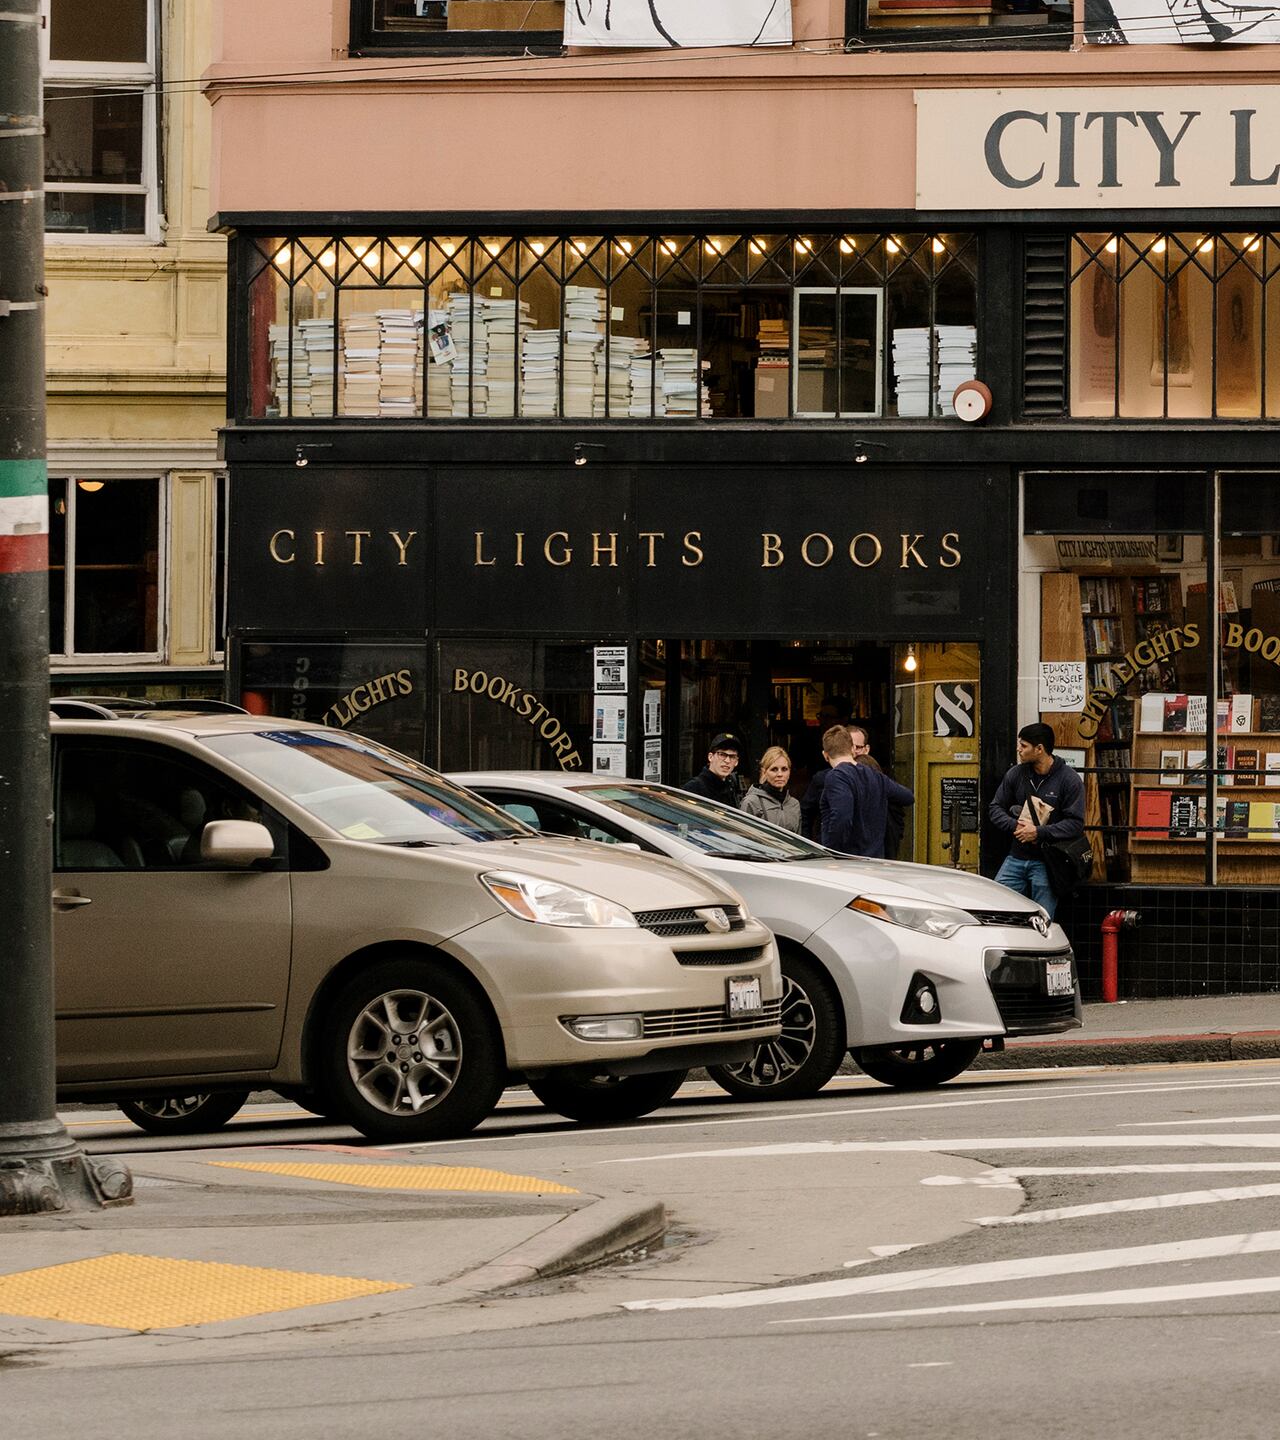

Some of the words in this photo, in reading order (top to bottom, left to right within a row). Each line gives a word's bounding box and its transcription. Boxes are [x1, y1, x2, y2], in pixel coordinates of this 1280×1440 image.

[983, 107, 1201, 189] CITY
[269, 529, 418, 566] CITY
[474, 531, 704, 568] LIGHTS
[761, 532, 963, 569] BOOKS
[1057, 540, 1077, 558] CITY
[1078, 540, 1107, 558] LIGHTS
[1043, 664, 1081, 675] EDUCATE
[1043, 675, 1082, 686] YOURSELF
[1076, 673, 1118, 741] CITY
[1110, 623, 1201, 685] LIGHTS
[330, 669, 414, 727] LIGHTS
[454, 668, 582, 773] BOOKSTORE
